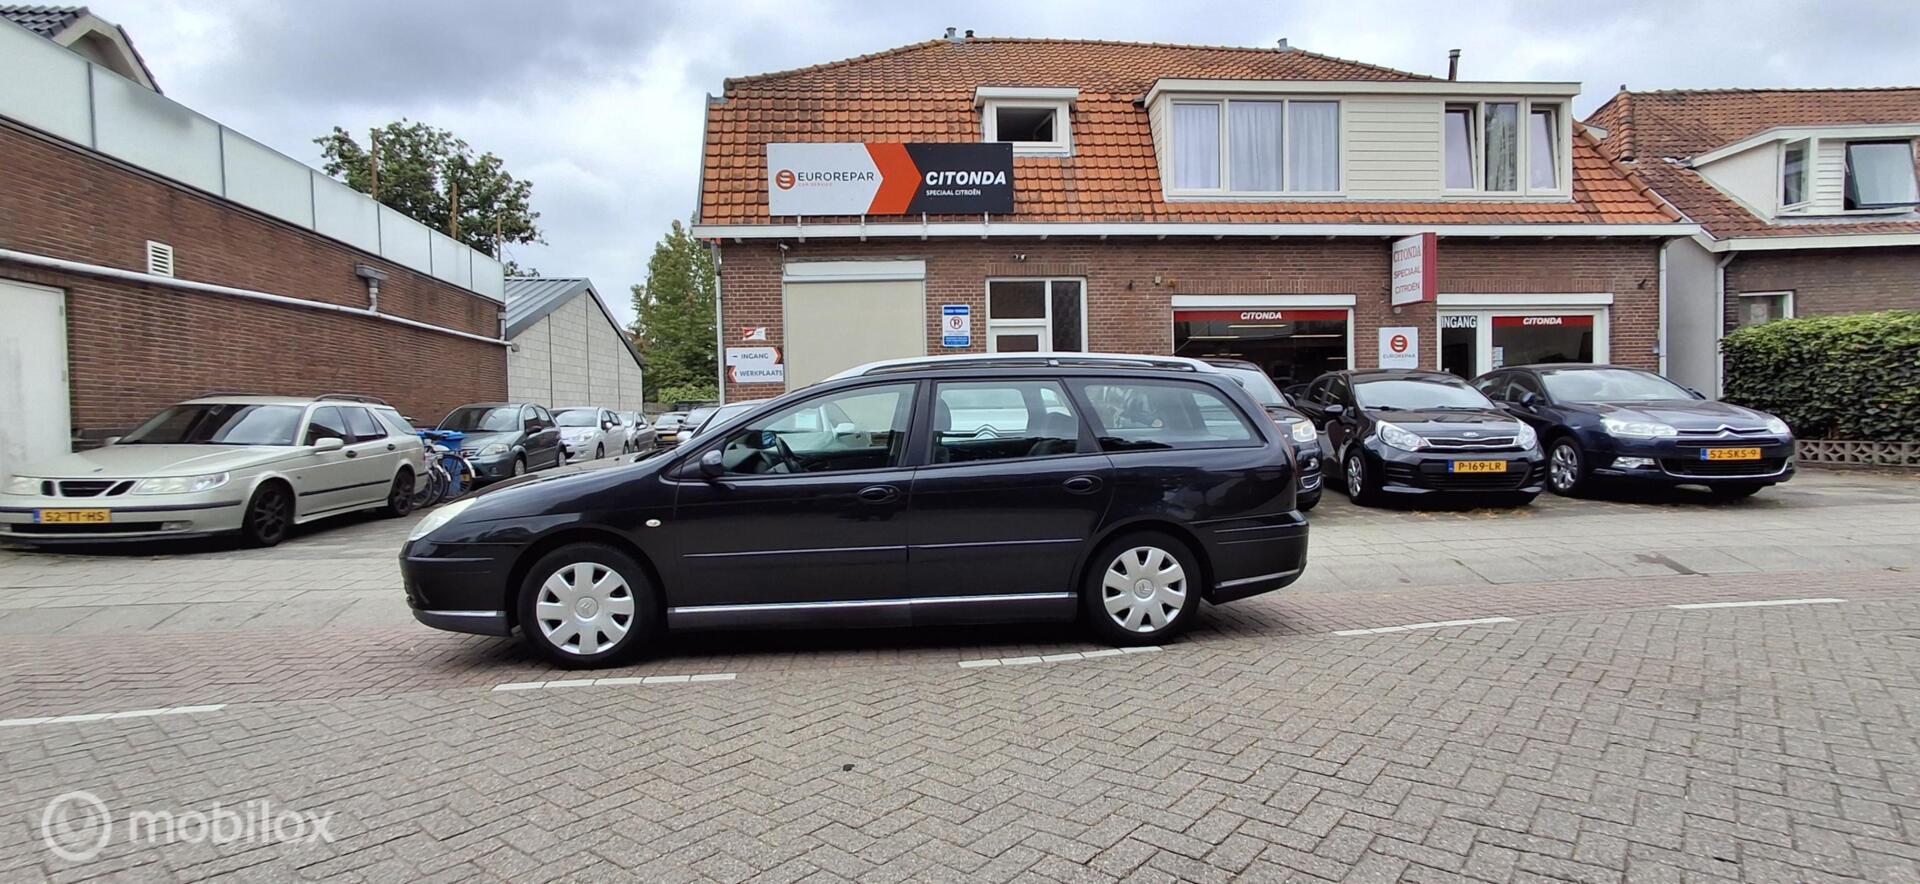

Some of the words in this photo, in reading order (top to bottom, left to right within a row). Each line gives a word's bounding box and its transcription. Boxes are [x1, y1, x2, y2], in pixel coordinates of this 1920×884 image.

[798, 172, 874, 182] EUROREPAR
[926, 171, 1007, 185] CITONDA
[955, 188, 981, 196] CITROËN
[1394, 246, 1421, 262] CITONDA
[1394, 267, 1421, 279] SPECIAAL
[1240, 311, 1282, 320] CITONDA
[1441, 316, 1477, 328] INGANG
[1523, 317, 1562, 325] CITONDA
[1710, 449, 1757, 459] 52-SKS-9
[1458, 462, 1502, 471] P-169-LR
[45, 511, 105, 522] 52-TT-HS
